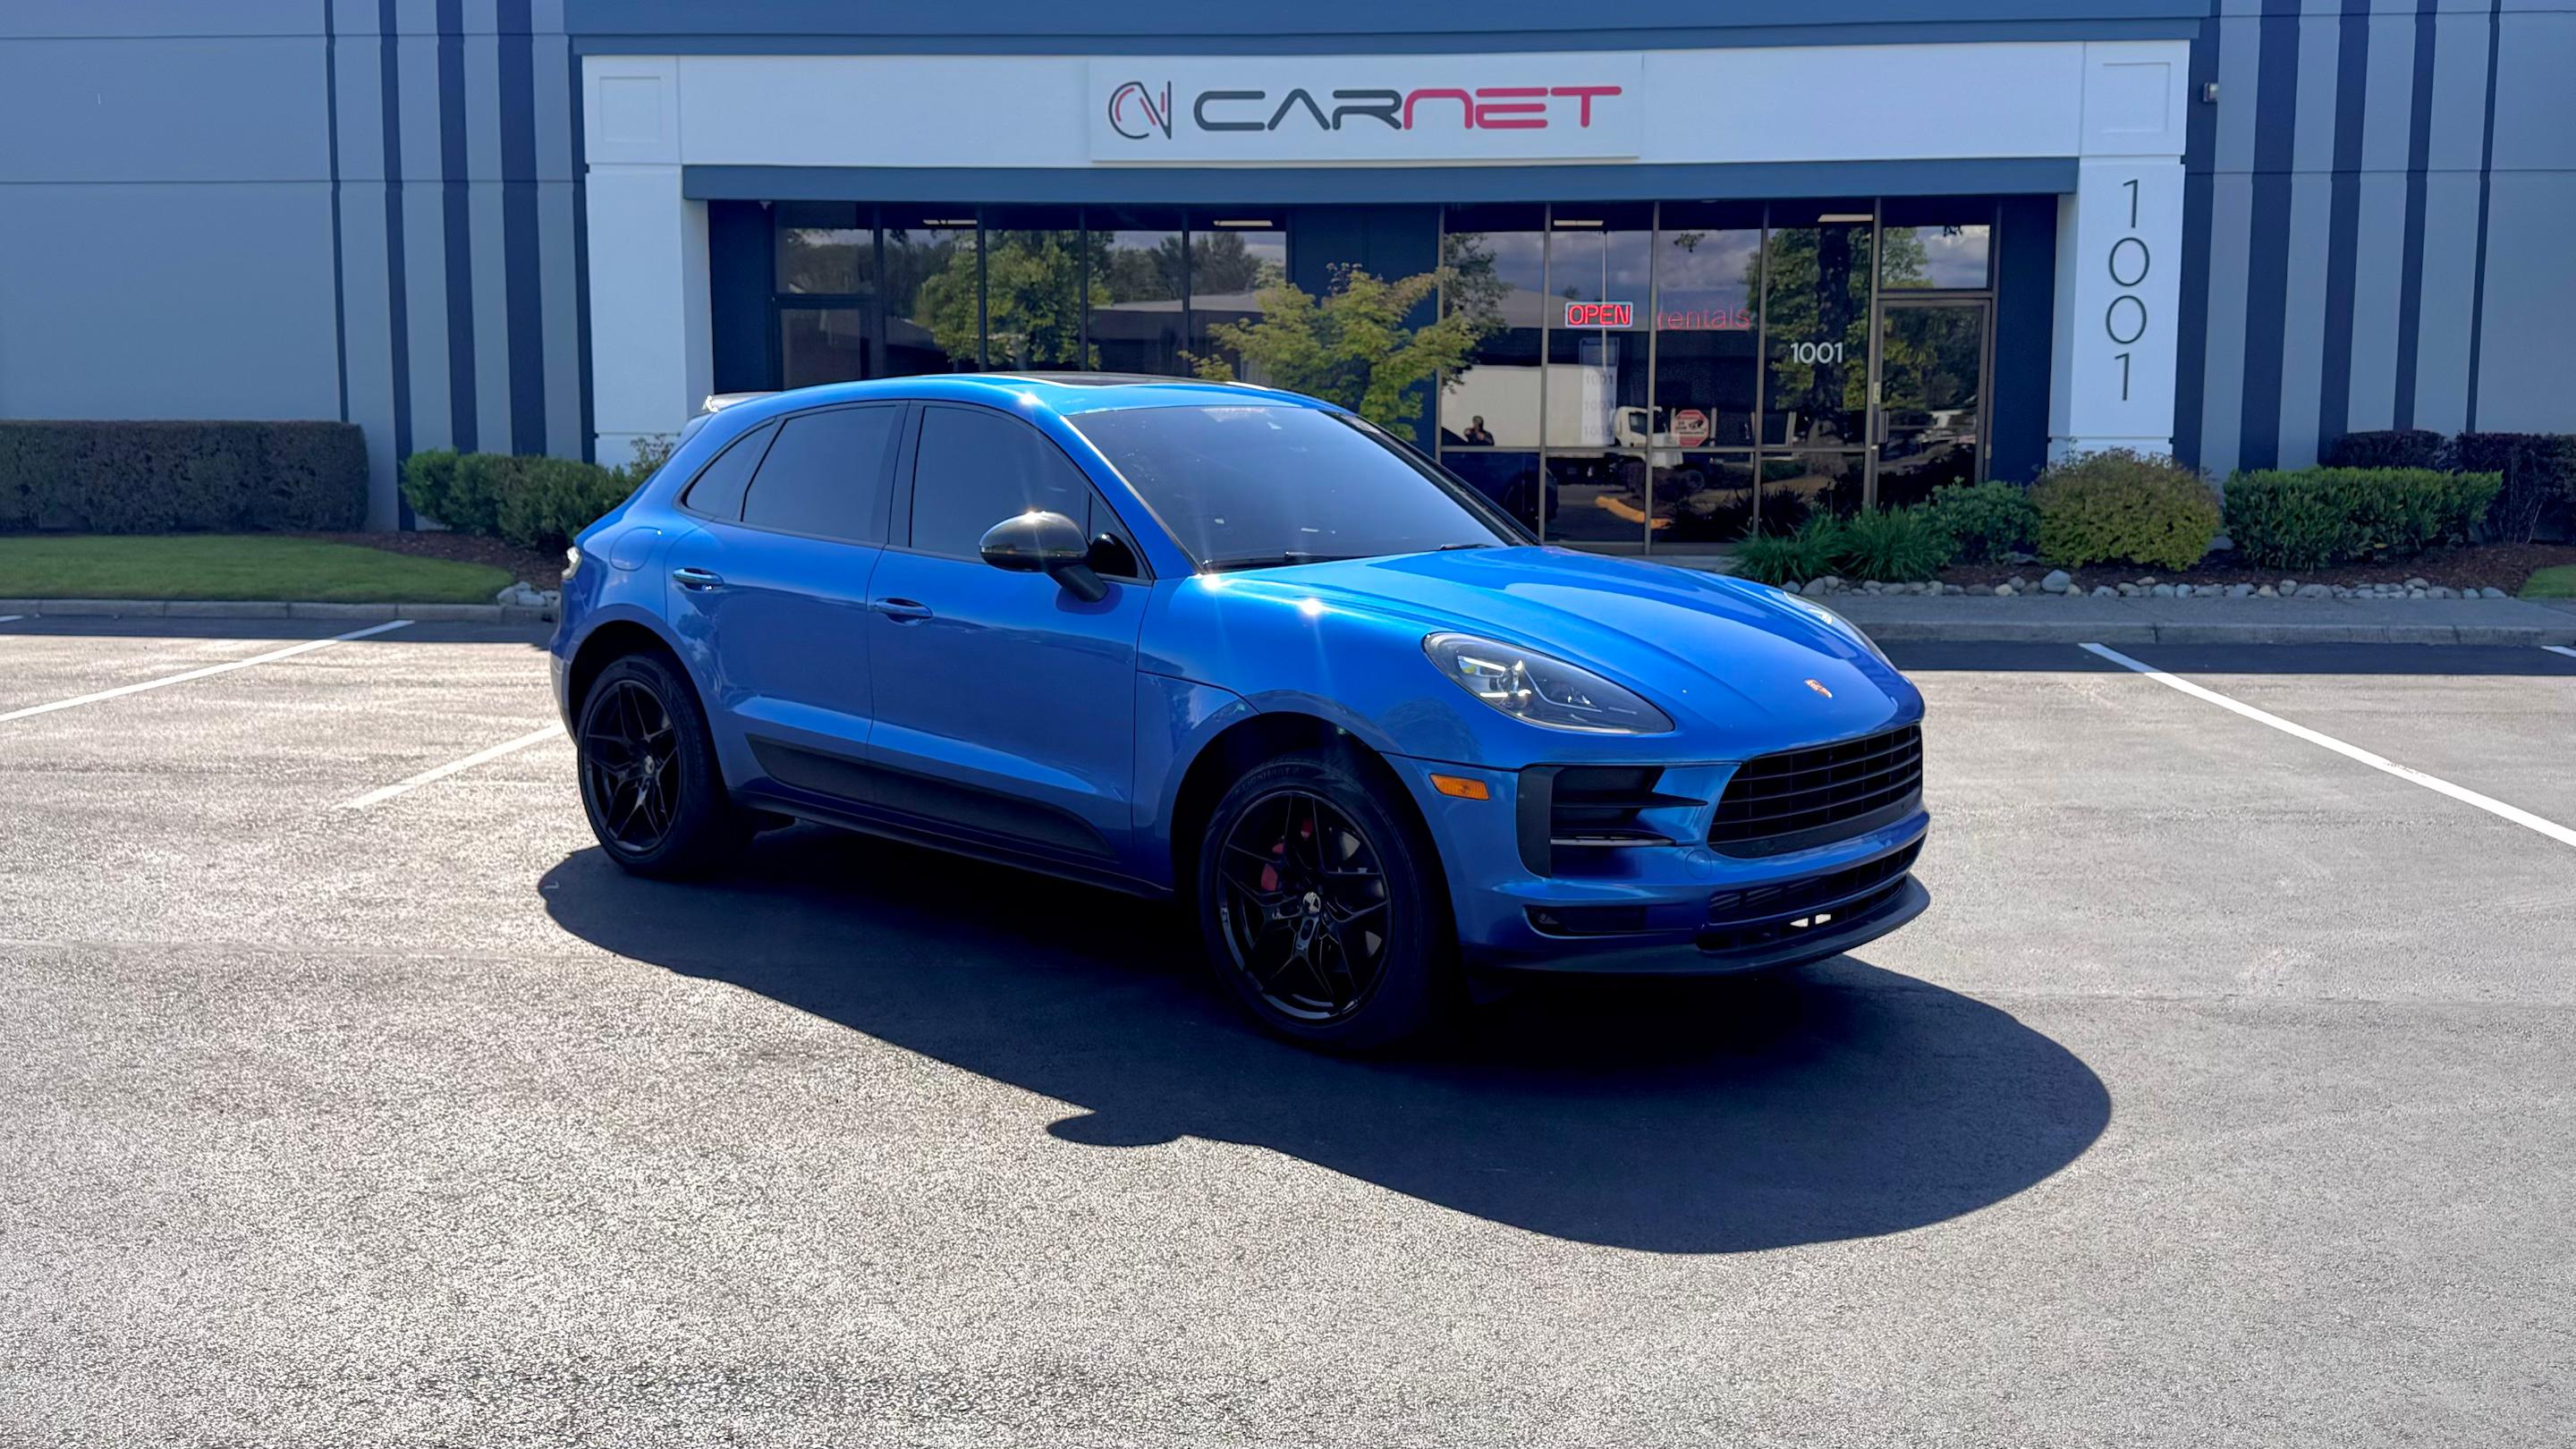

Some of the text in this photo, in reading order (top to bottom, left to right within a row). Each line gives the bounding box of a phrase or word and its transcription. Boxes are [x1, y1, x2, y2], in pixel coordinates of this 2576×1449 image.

[1193, 86, 1623, 131] CARNET
[2106, 179, 2150, 402] 1001
[1569, 304, 1631, 325] OPEN
[1657, 304, 1750, 330] rentals
[1791, 342, 1843, 364] 1001
